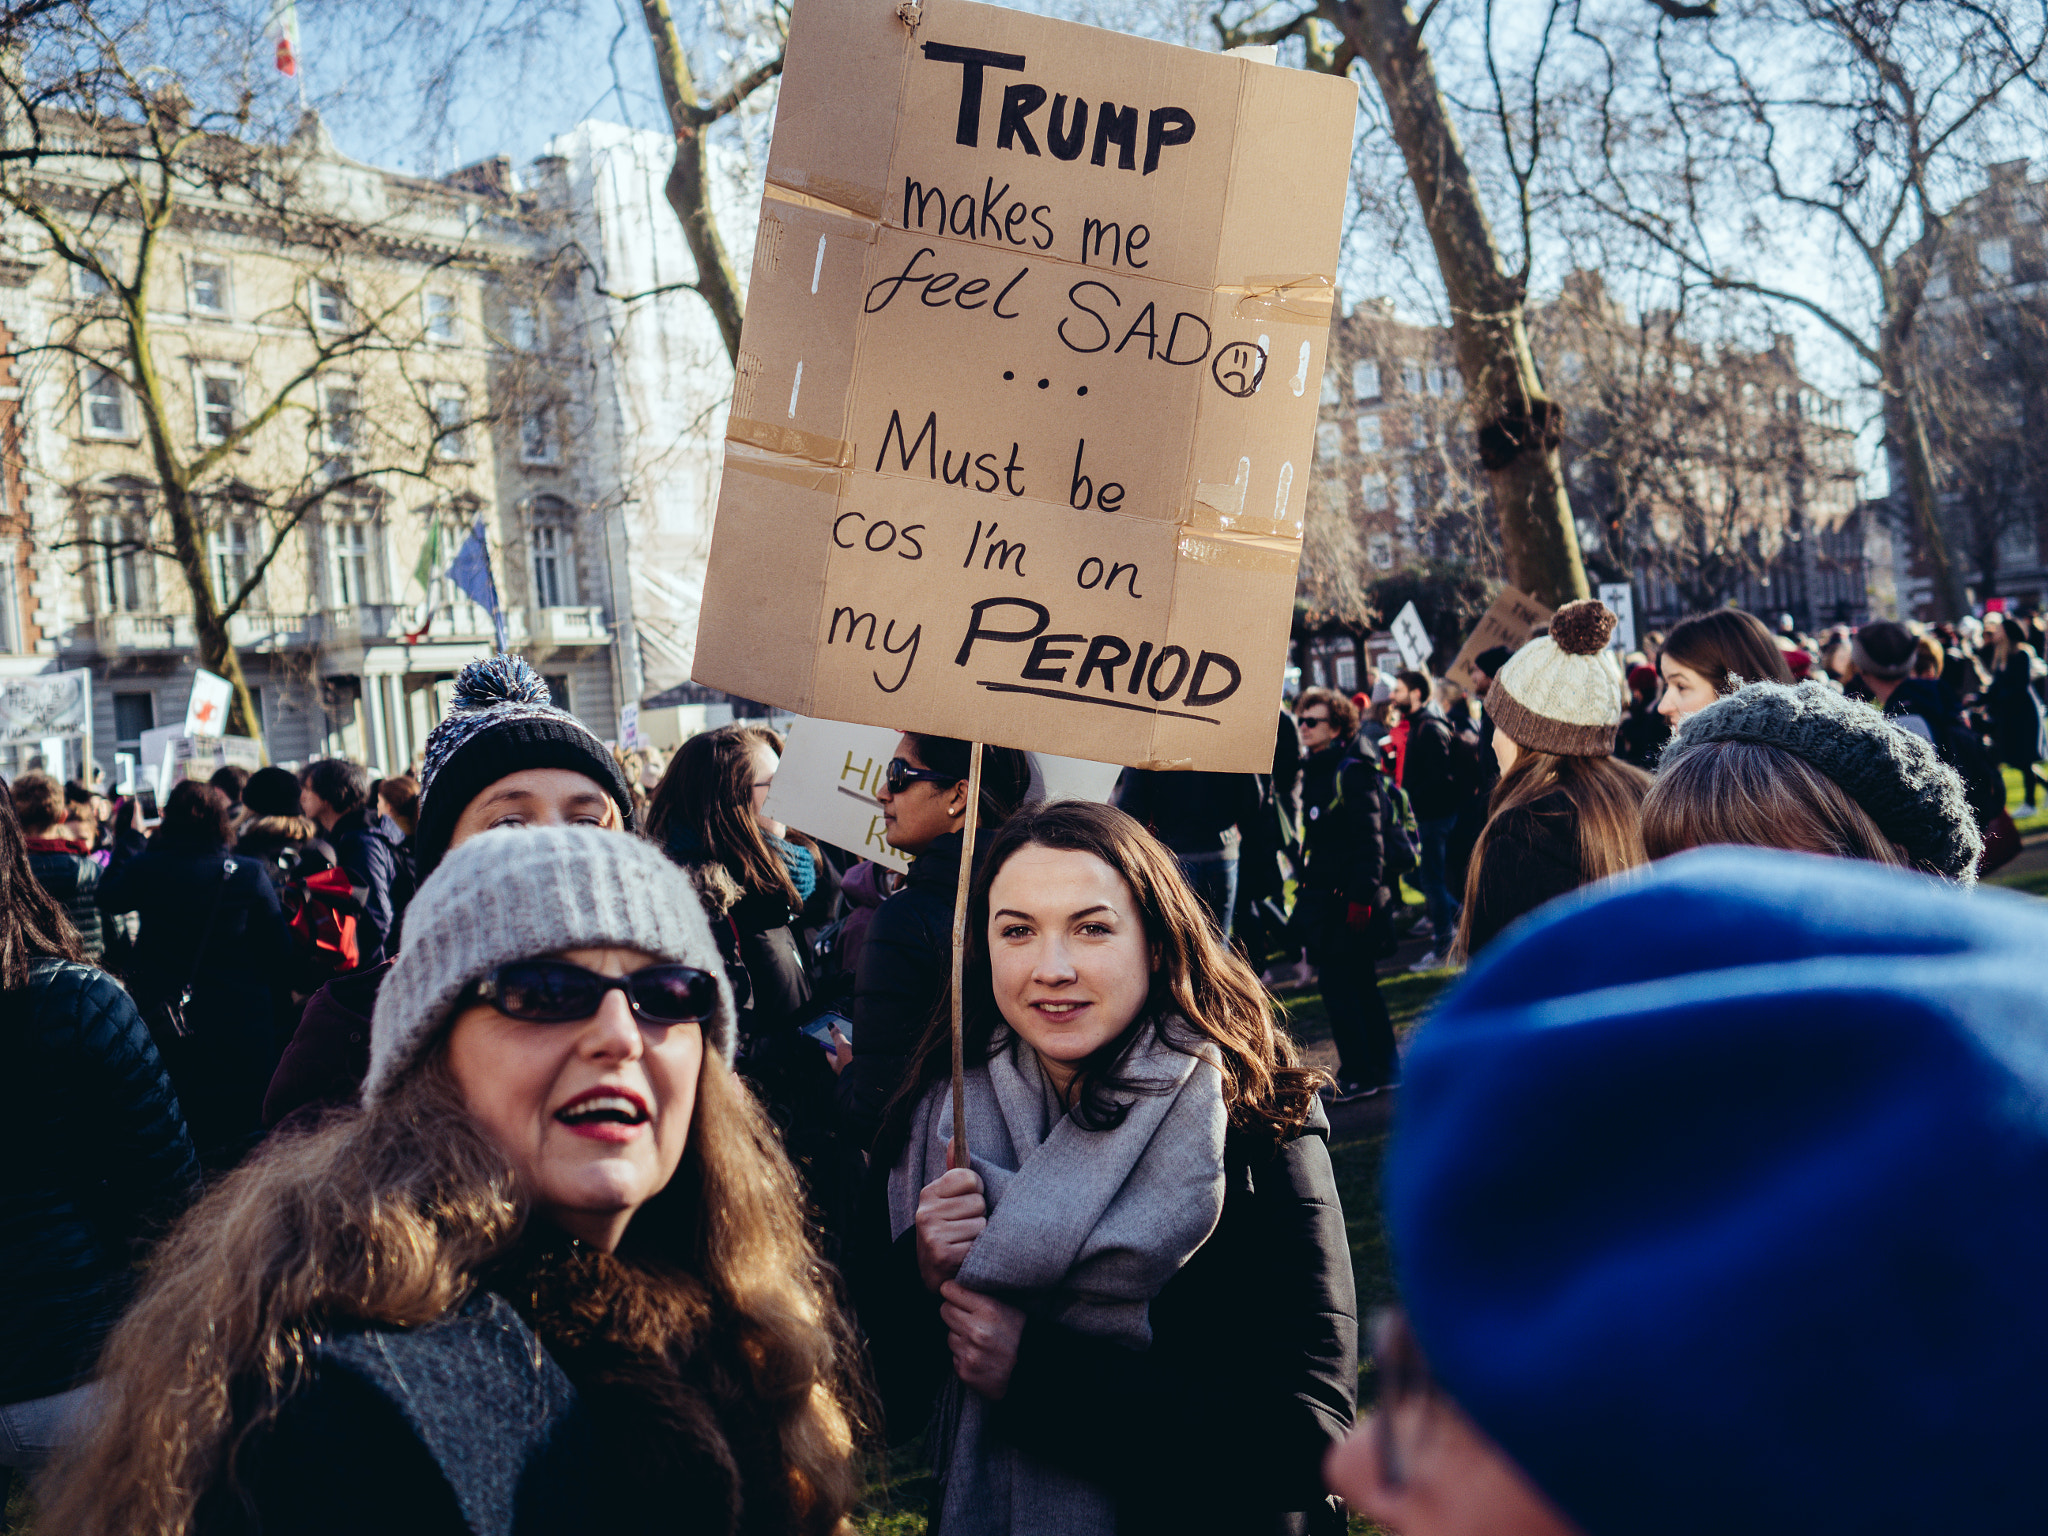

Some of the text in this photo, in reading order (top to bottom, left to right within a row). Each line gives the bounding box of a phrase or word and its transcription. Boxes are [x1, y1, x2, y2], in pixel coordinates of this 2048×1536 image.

[921, 41, 1195, 175] TRUMP
[903, 177, 1149, 268] makes me
[865, 248, 1211, 365] feel SAD
[876, 410, 1125, 512] Must be
[833, 513, 1141, 598] cos I'm on
[828, 597, 1241, 707] my PERIOD
